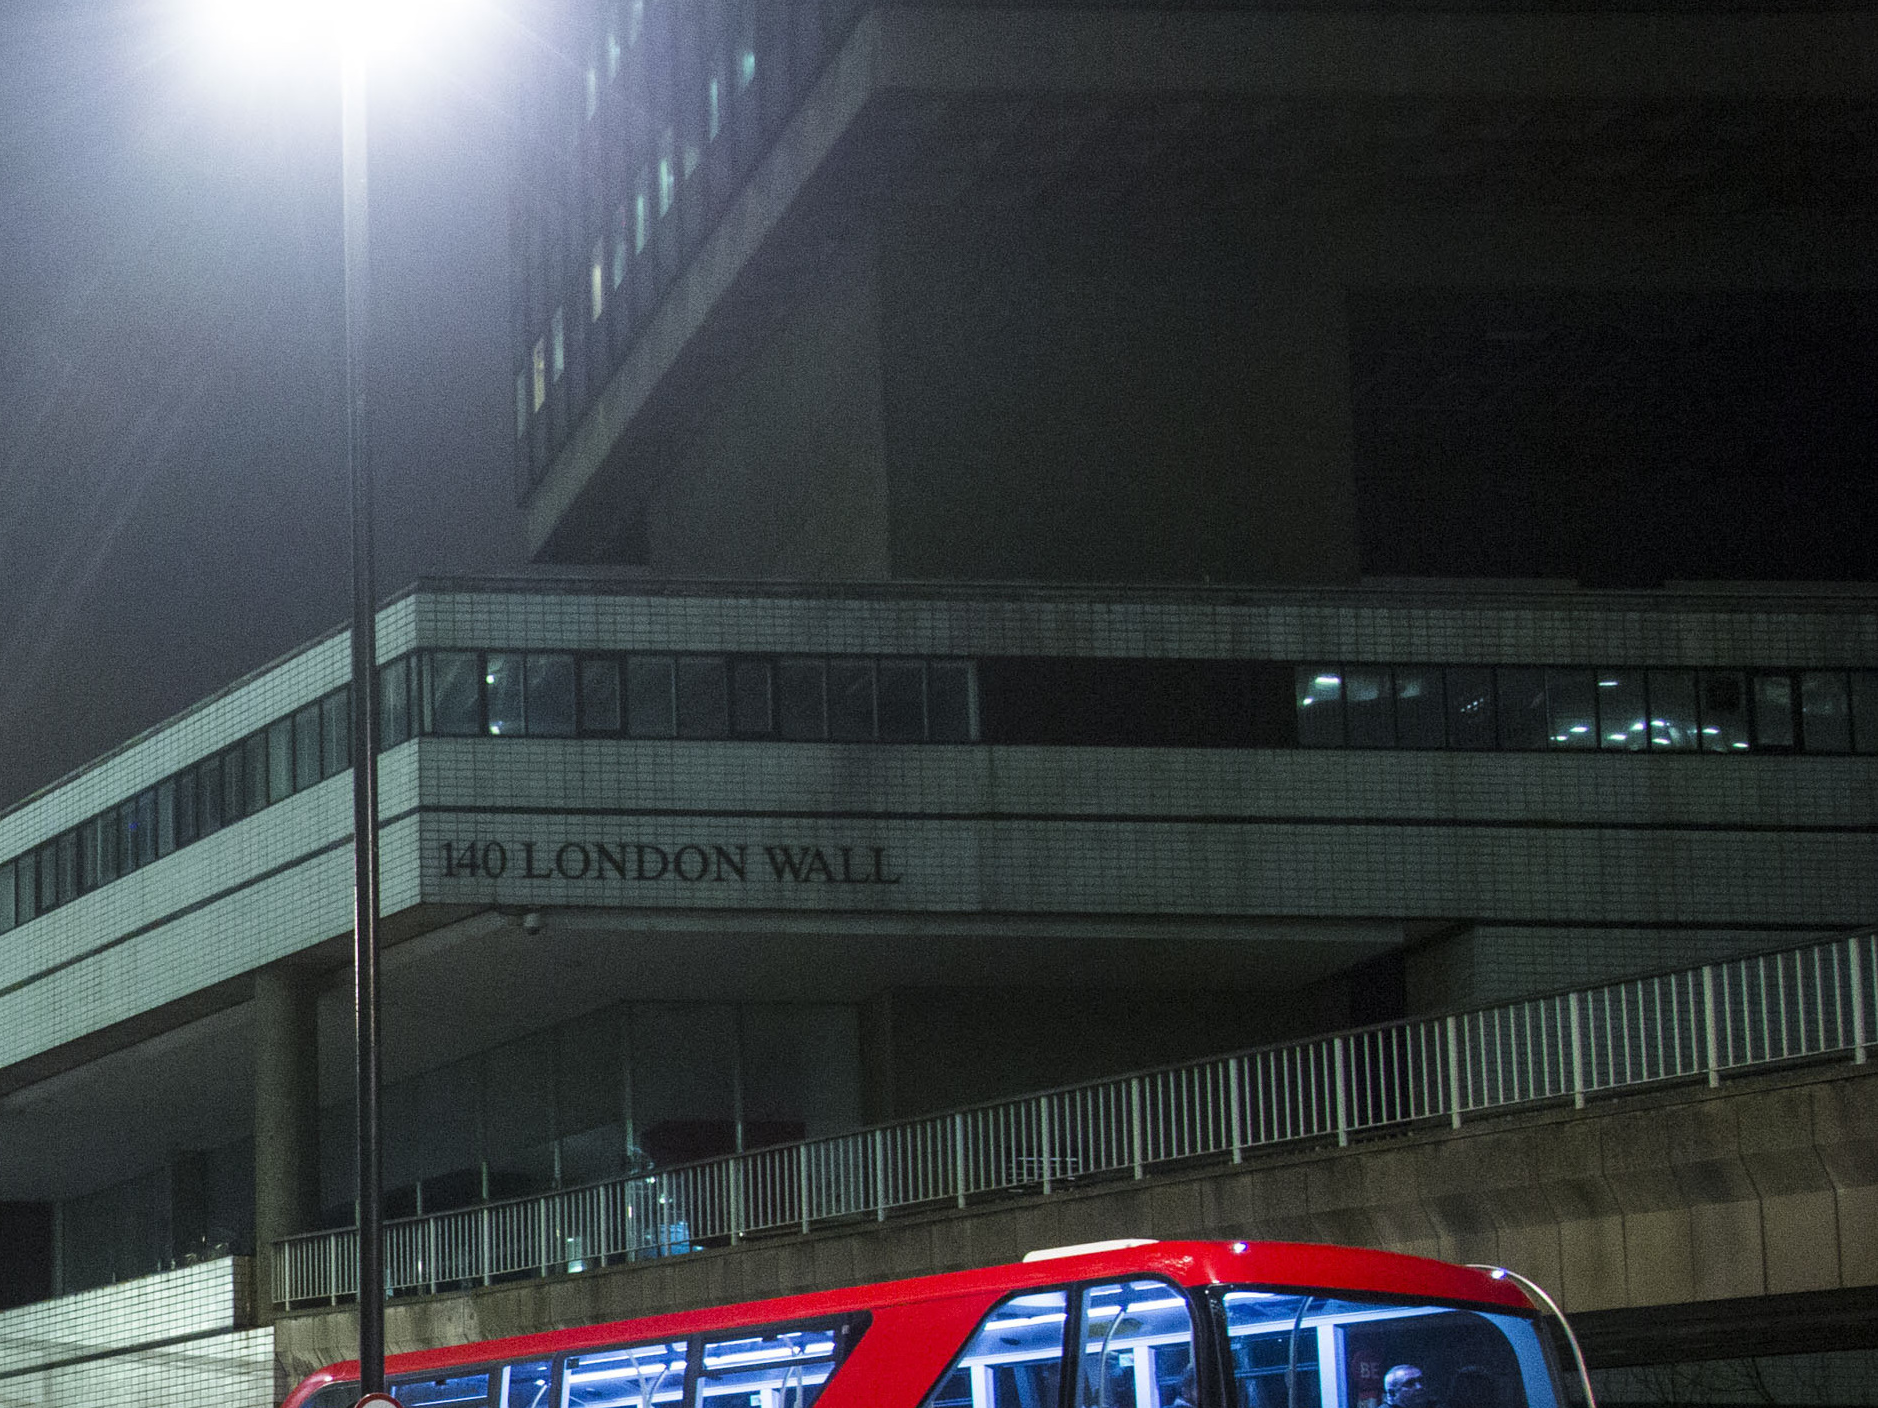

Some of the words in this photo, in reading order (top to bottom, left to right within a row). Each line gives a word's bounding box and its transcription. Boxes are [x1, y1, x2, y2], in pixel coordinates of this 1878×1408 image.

[439, 841, 508, 880] 140
[523, 841, 749, 883] LONDON
[765, 845, 902, 885] WALL
